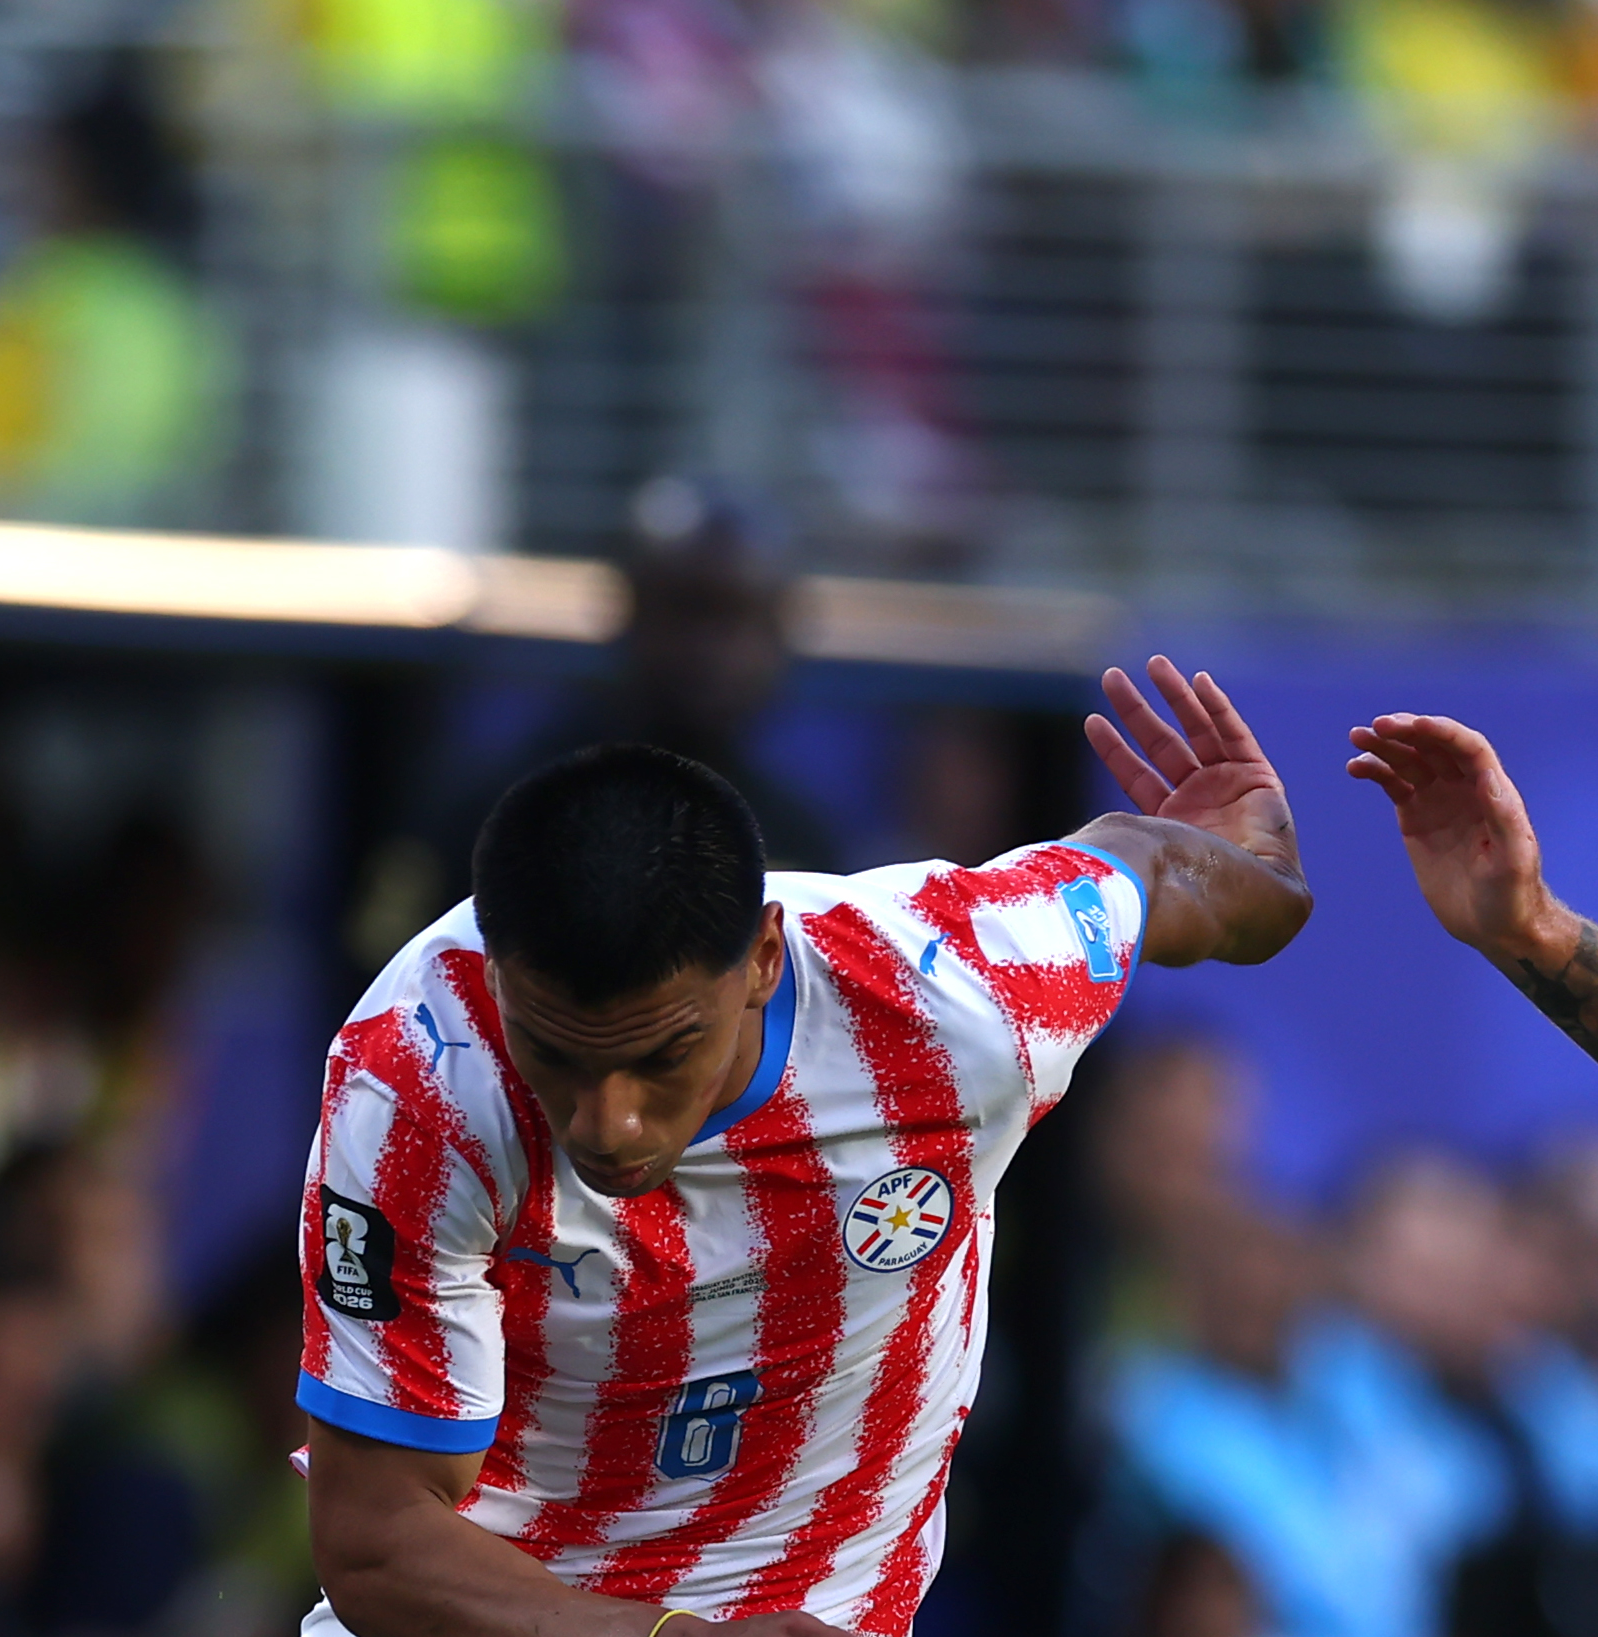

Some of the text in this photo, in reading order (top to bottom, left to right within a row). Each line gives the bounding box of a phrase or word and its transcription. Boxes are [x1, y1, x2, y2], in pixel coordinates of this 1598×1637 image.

[877, 1172, 913, 1199] APF
[877, 1242, 928, 1266] PARAGUAY
[336, 1265, 360, 1278] FIFA
[654, 1369, 765, 1482] 8
